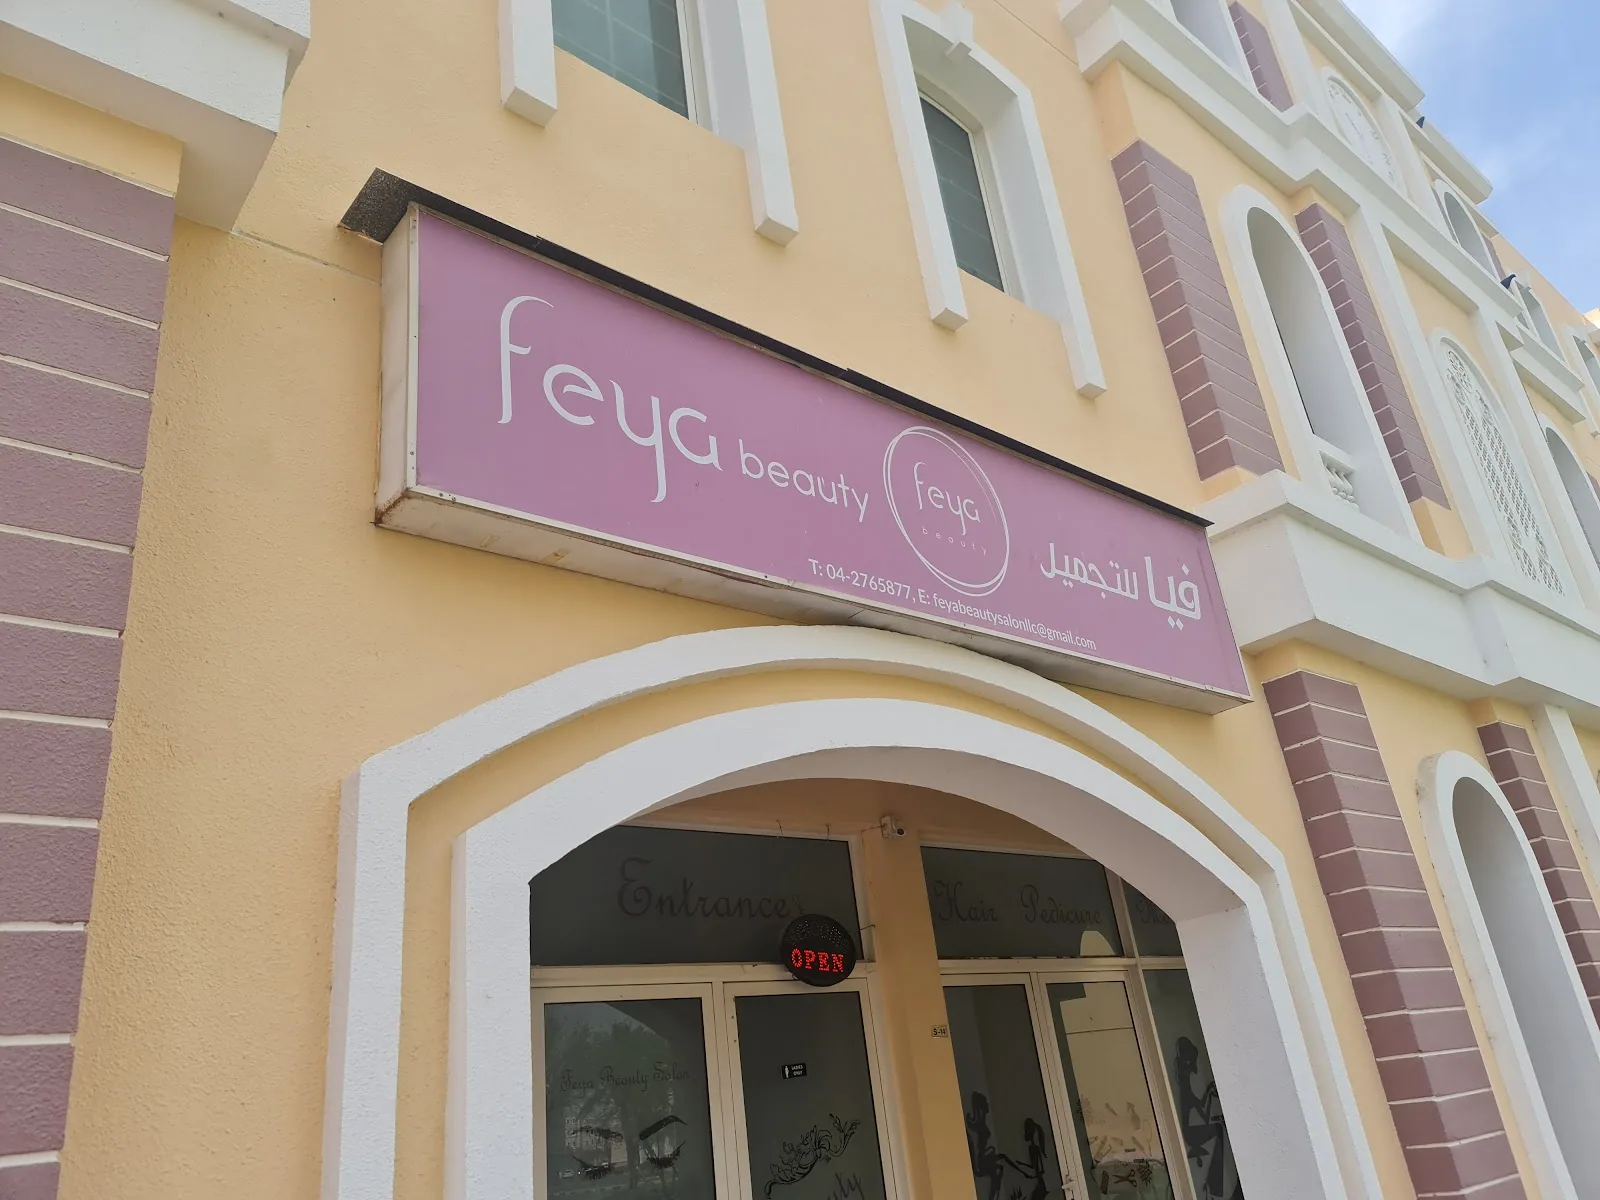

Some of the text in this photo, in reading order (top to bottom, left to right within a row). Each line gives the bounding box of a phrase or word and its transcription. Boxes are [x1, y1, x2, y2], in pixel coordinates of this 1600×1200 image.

[497, 295, 869, 523] feya beauty
[913, 461, 981, 536] feya
[921, 525, 987, 556] beauty
[808, 558, 823, 577] T:
[917, 588, 931, 605] E:
[933, 592, 1097, 650] feyabeautysalonllc@gmail.com
[1143, 555, 1202, 631] فيا
[933, 879, 998, 923] Hair
[1019, 884, 1103, 924] Pedicure
[791, 948, 844, 973] OPEN
